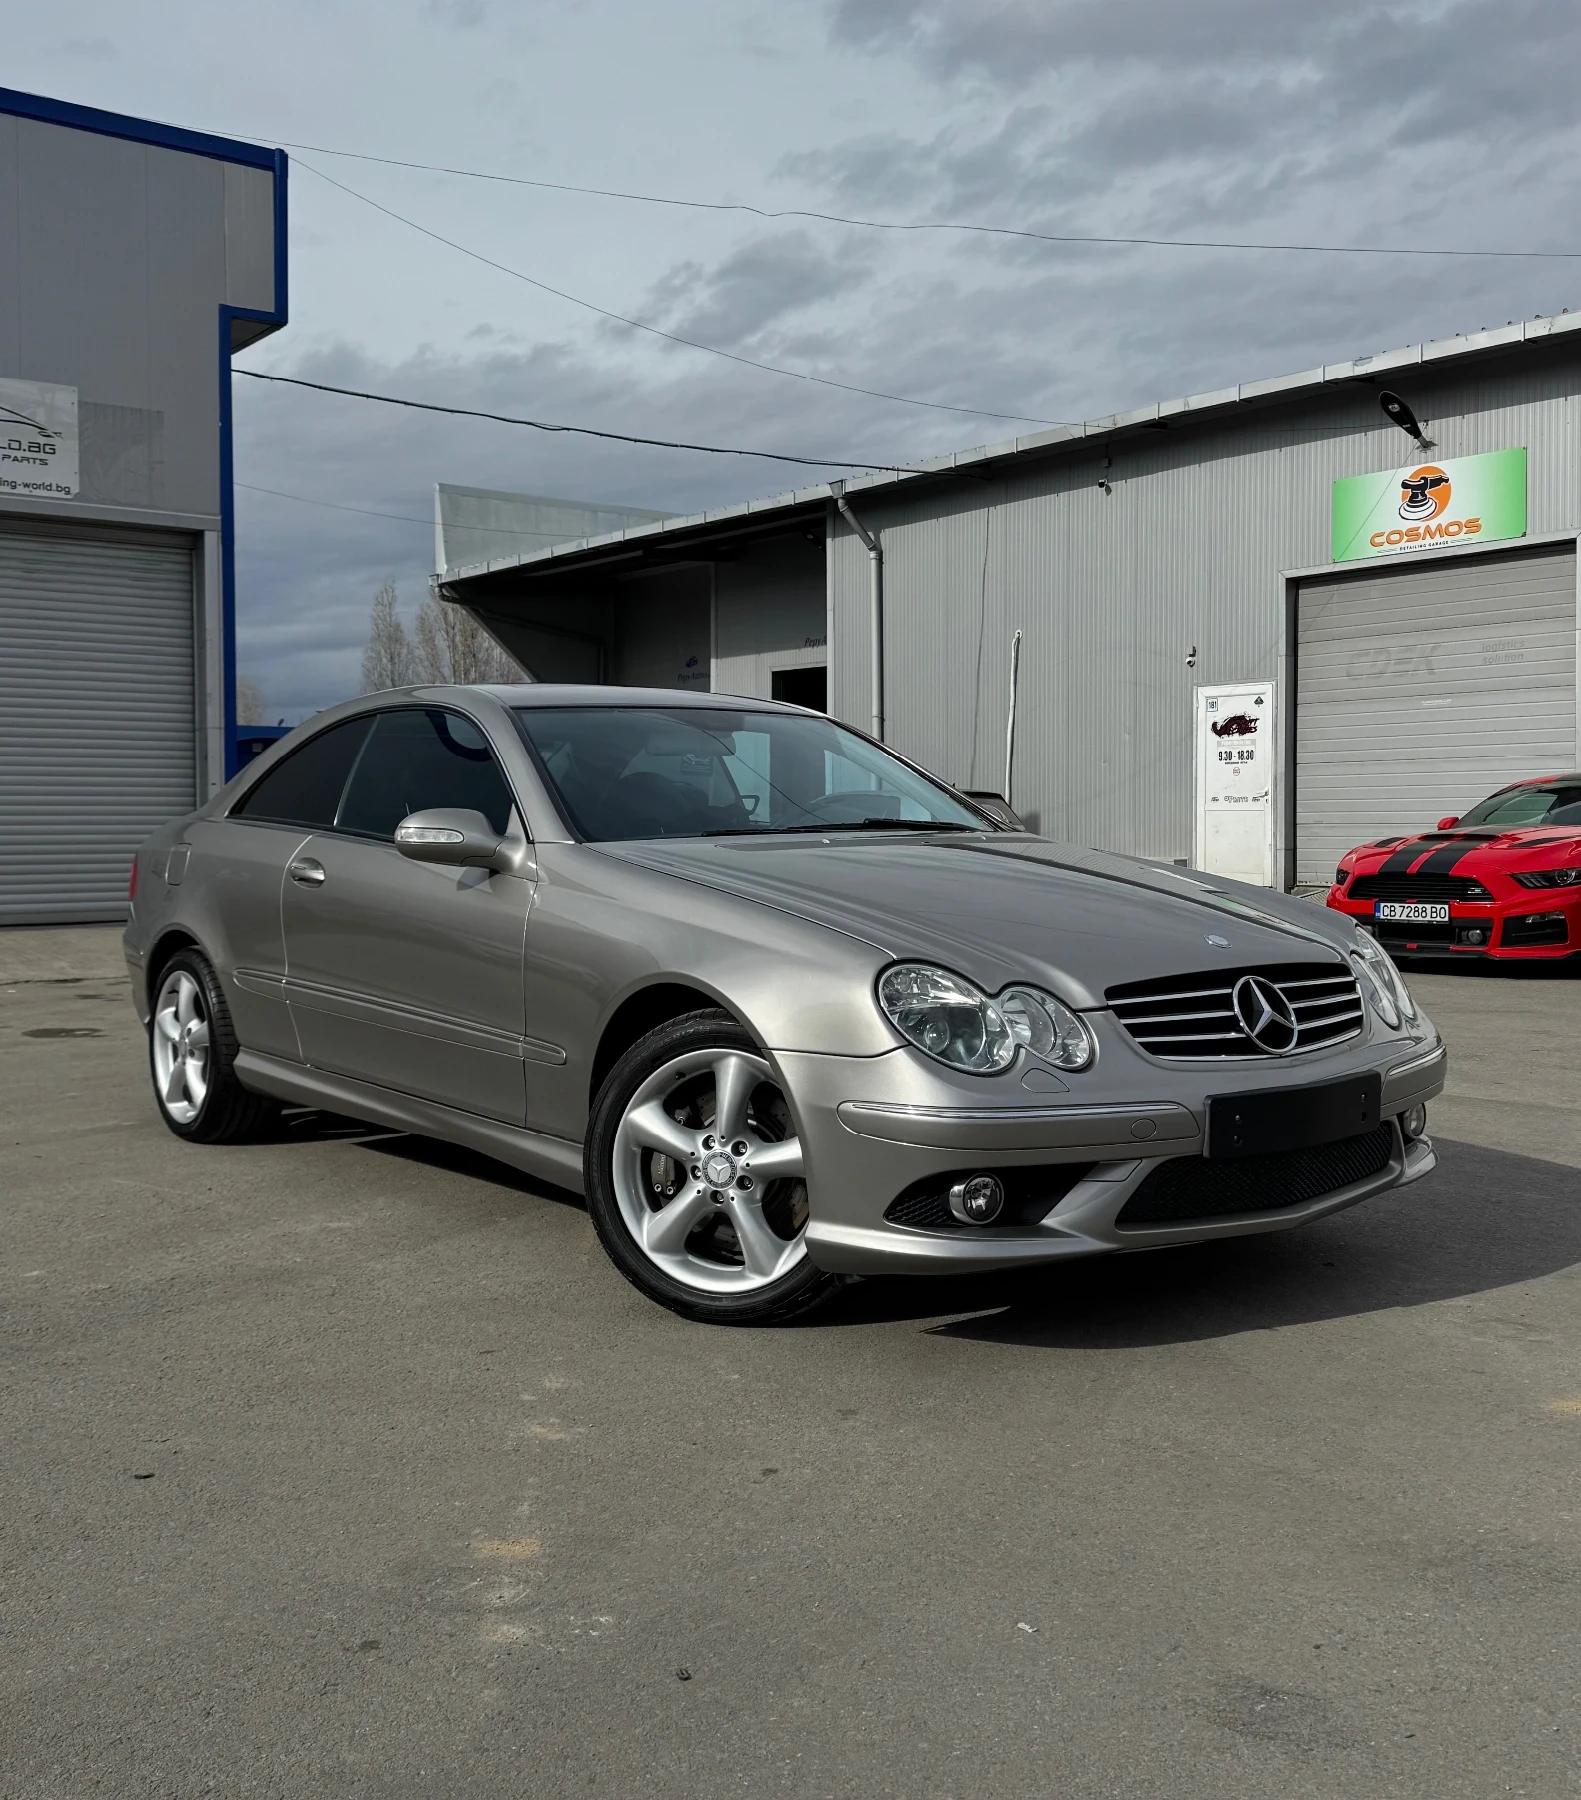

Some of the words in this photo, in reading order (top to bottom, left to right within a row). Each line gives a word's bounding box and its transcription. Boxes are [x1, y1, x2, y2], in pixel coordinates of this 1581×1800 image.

[1, 454, 49, 466] PARTS
[1369, 517, 1482, 547] COSMOS
[1399, 542, 1427, 551] DETAILING
[1428, 540, 1449, 548] GARAGE
[1218, 750, 1233, 761] 9.30
[1237, 749, 1254, 761] 18.30
[1382, 904, 1397, 918] CB
[1399, 905, 1428, 919] 7288
[1430, 905, 1447, 919] BO
